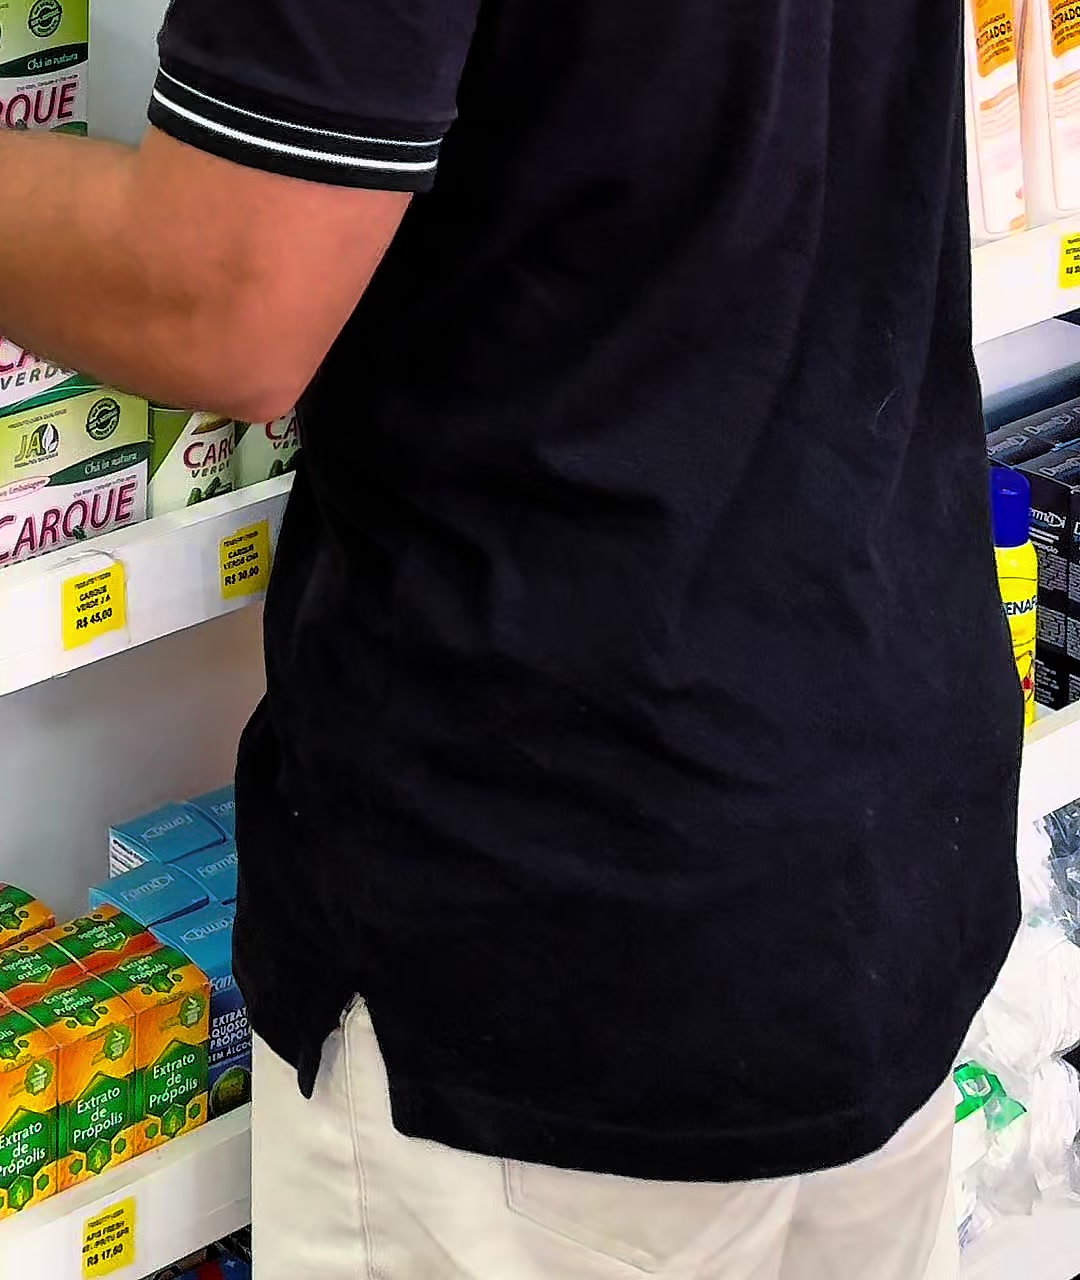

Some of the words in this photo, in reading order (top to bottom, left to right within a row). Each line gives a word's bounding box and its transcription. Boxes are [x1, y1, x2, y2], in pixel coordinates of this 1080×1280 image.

[225, 574, 236, 586] R$
[76, 617, 88, 630] R$
[129, 962, 169, 982] Própolis
[53, 995, 94, 1016] Própolis
[152, 1052, 195, 1079] Extrato
[166, 1071, 182, 1086] de
[77, 1086, 120, 1115] Extrato
[149, 1076, 199, 1107] Própolis
[90, 1106, 106, 1121] de
[73, 1111, 123, 1143] Própolis
[12, 1140, 29, 1156] de
[87, 1254, 99, 1267] R$
